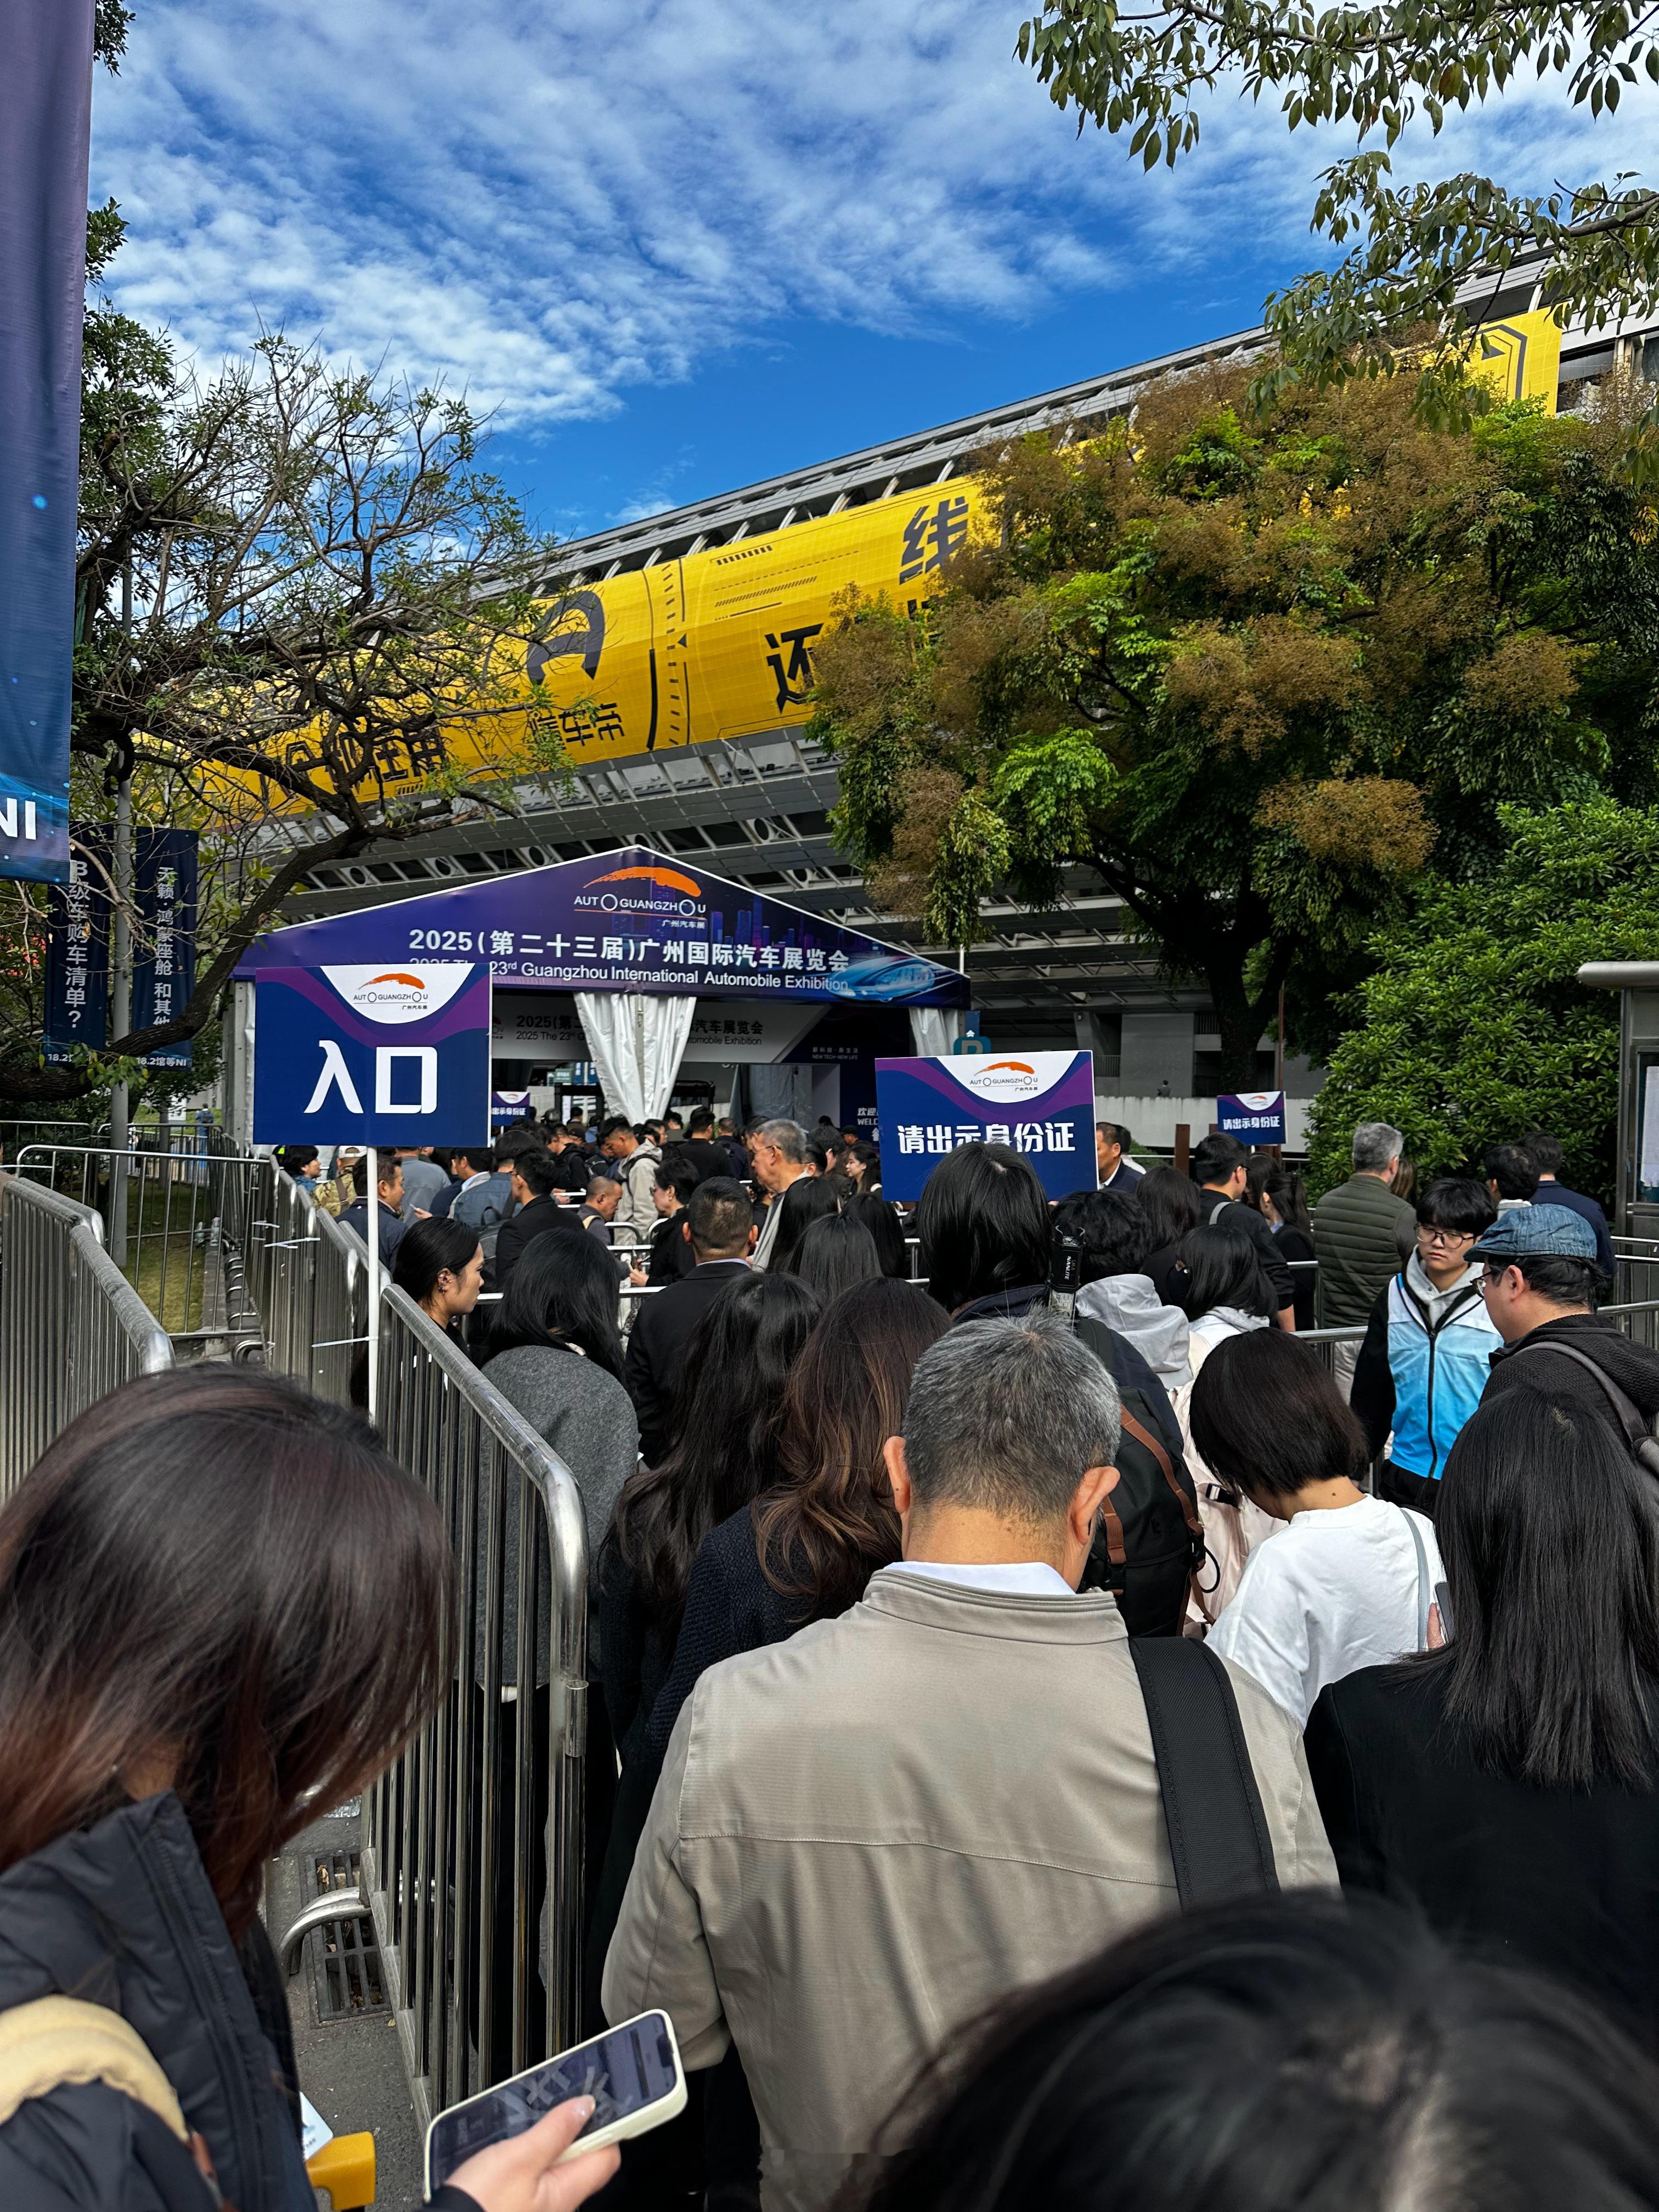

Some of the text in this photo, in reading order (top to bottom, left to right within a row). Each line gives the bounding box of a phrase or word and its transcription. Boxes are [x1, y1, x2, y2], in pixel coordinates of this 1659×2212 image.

[899, 496, 969, 585] 线
[764, 623, 825, 714] 还
[662, 919, 706, 929] 广州汽车展
[409, 929, 849, 972] 2025(第二十三届)广州国际汽车展览会
[521, 962, 607, 981] Guangzhou
[611, 966, 698, 984] International
[704, 970, 781, 988] Automobile
[785, 975, 848, 990] Exhibition
[516, 1031, 538, 1040] 2025
[540, 1031, 557, 1041] The
[724, 1036, 761, 1045] Exhibition
[304, 1040, 438, 1114] 入口
[857, 1108, 878, 1116] 欢迎
[1222, 1116, 1280, 1130] 请出示身份证
[898, 1122, 1076, 1154] 请出示身份证
